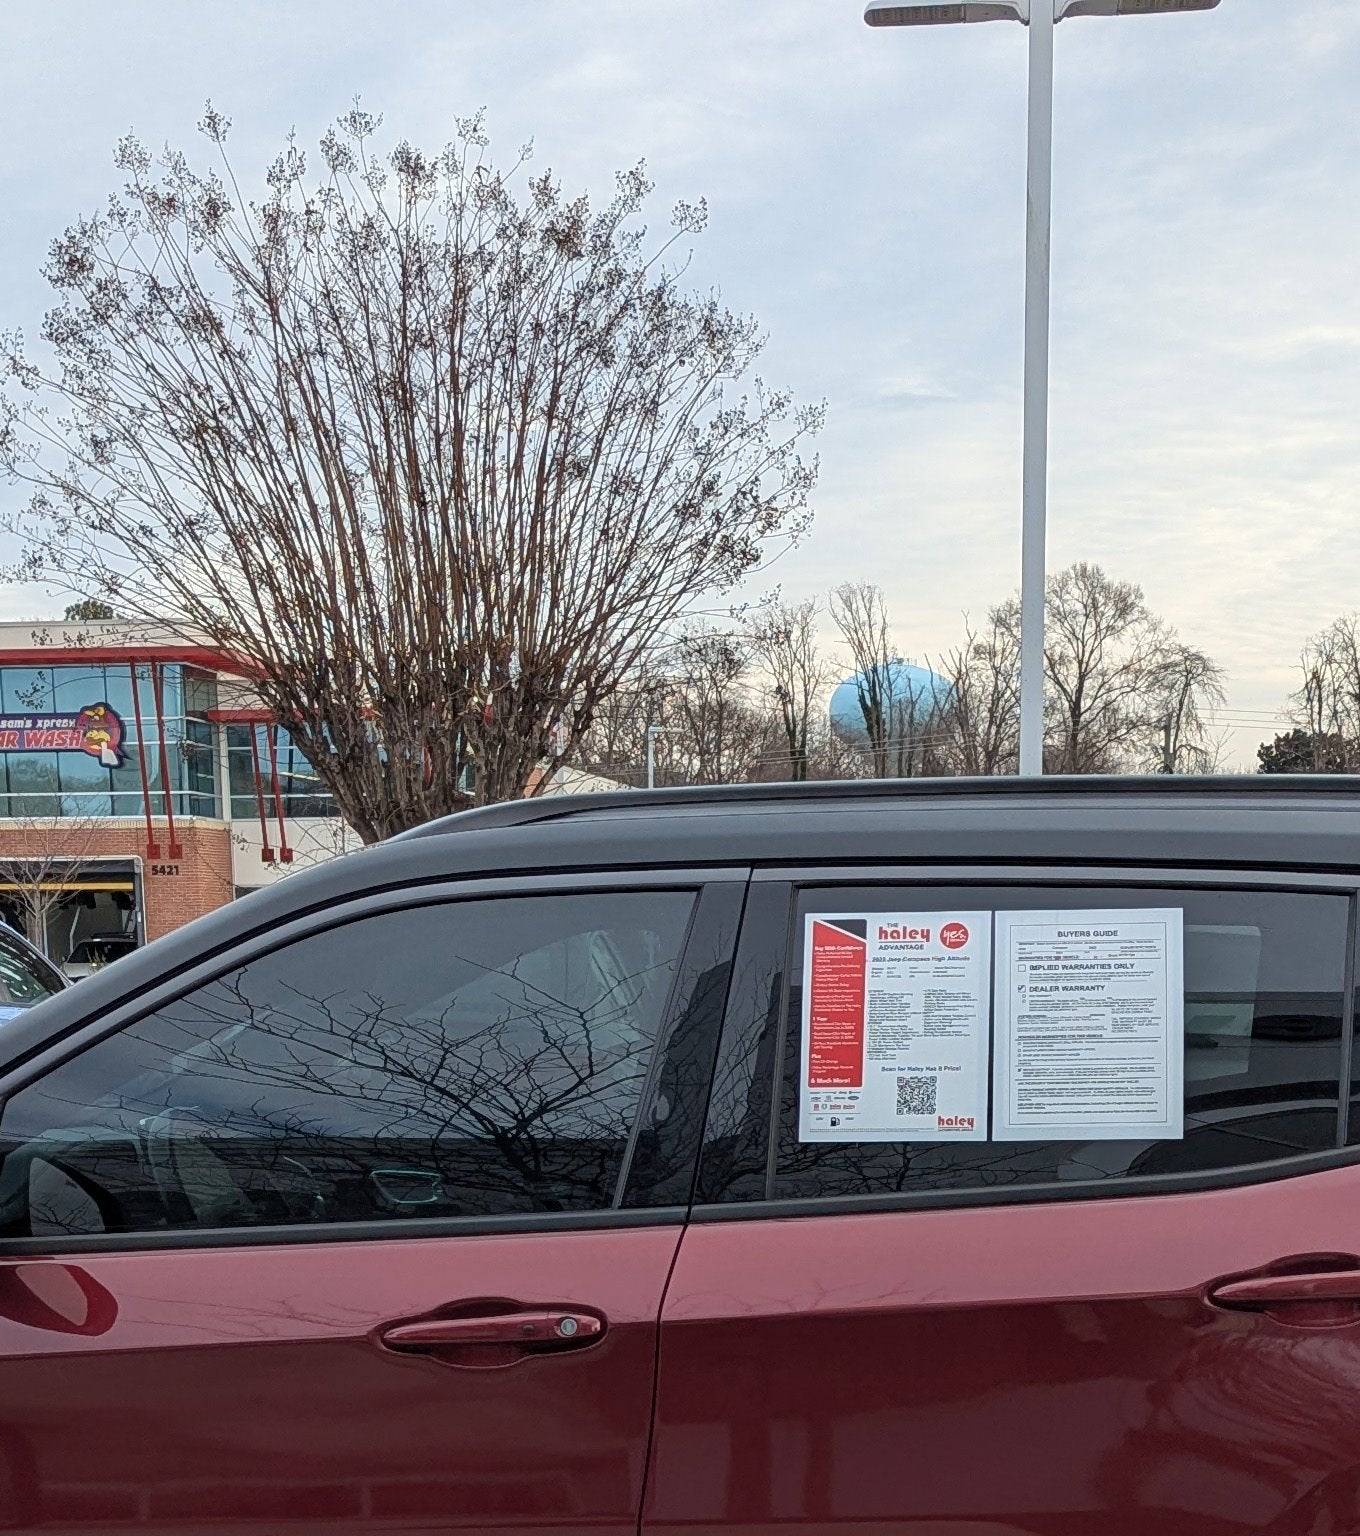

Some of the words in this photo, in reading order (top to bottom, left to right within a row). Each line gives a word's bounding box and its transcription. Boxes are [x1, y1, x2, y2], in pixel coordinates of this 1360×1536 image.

[24, 729, 84, 749] WASH
[151, 864, 179, 876] 5421
[878, 926, 931, 942] haley
[1057, 930, 1091, 938] BUYERS
[1093, 929, 1119, 937] GUIDE
[1061, 984, 1106, 992] WARRANTY
[937, 1115, 975, 1128] haley
